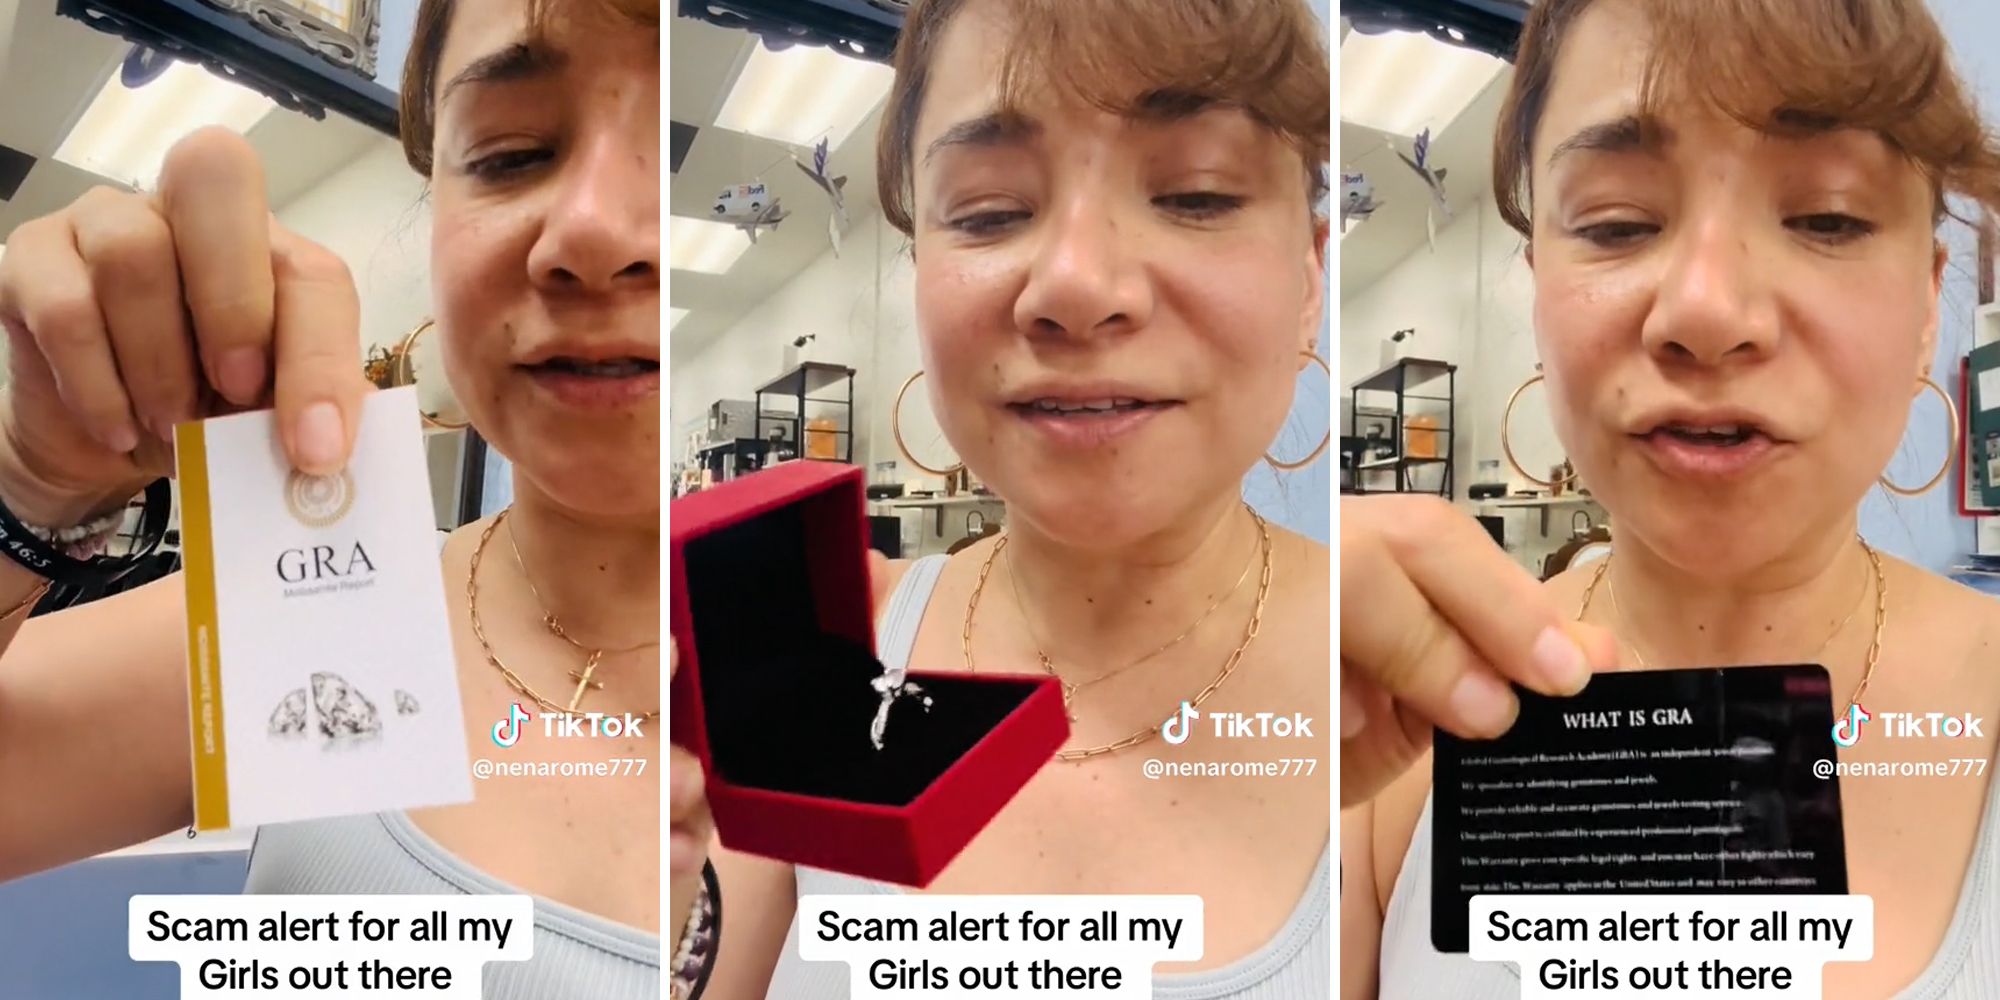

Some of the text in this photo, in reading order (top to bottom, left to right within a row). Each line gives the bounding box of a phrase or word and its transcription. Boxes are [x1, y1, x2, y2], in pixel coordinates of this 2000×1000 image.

[8, 541, 52, 568] 46:5
[276, 540, 376, 583] GRA
[1563, 707, 1693, 729] WHAT IS GRA
